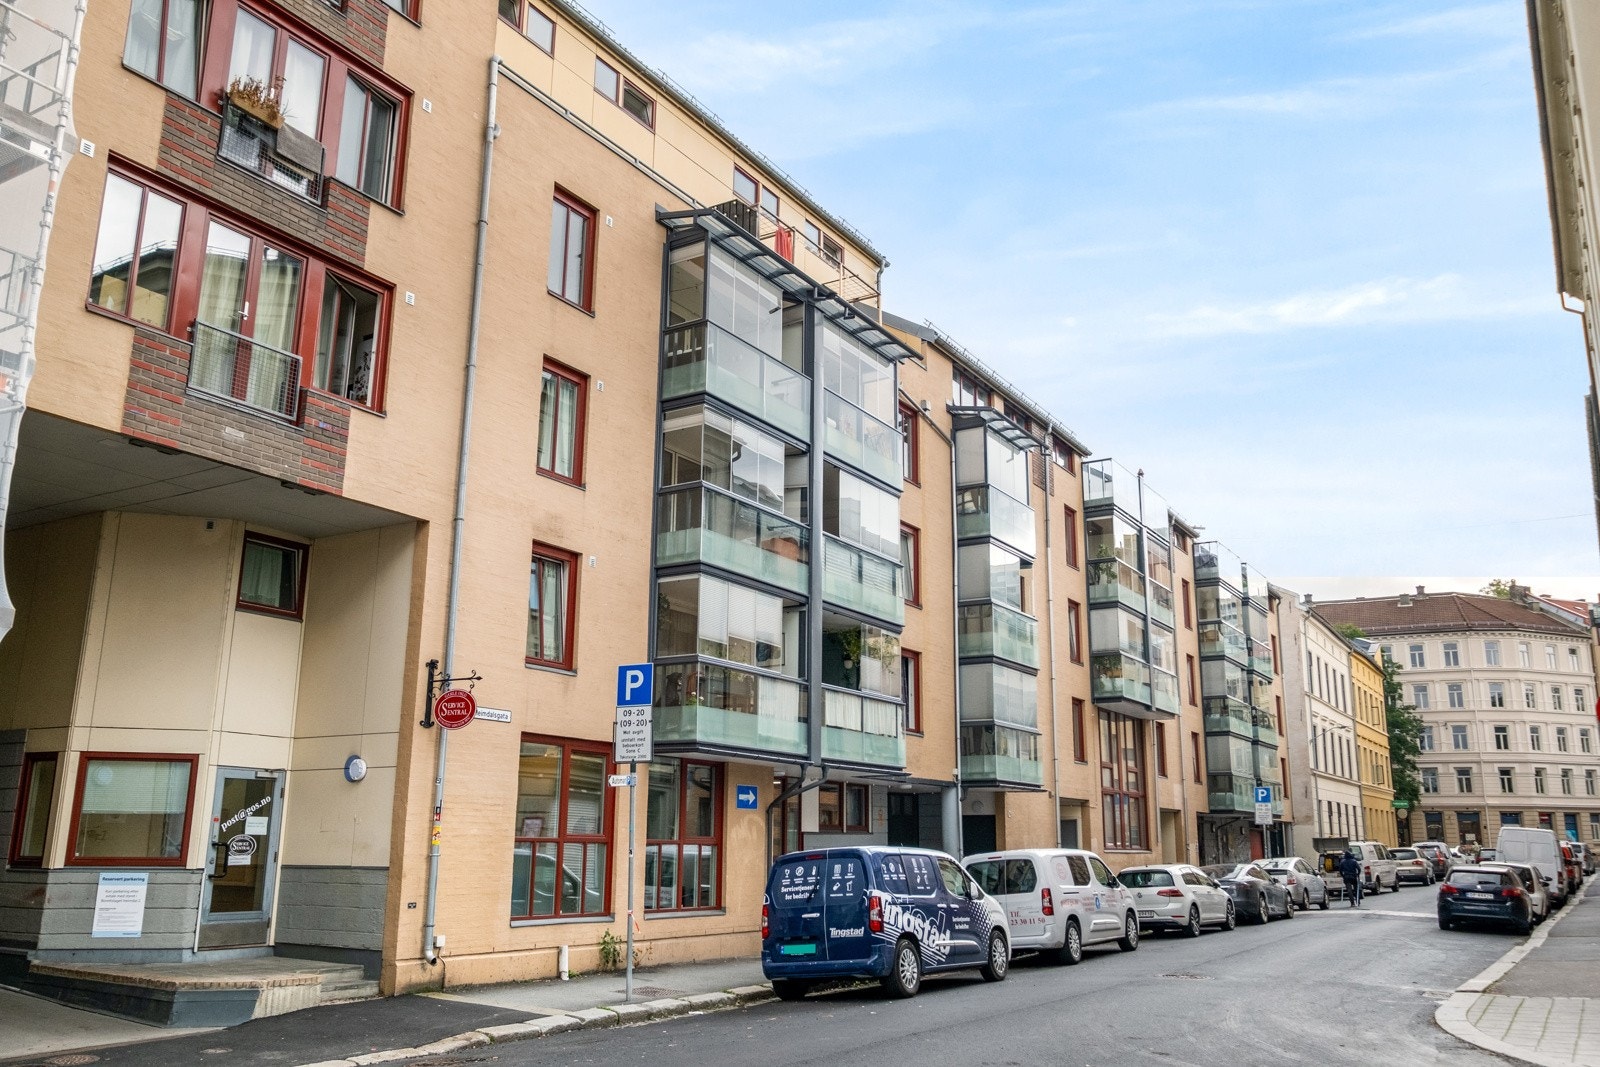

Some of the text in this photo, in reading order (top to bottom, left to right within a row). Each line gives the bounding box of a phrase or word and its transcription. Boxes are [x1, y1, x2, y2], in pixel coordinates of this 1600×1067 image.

[625, 669, 645, 701] P
[441, 701, 466, 712] SERVICE
[1258, 788, 1268, 801] P
[221, 796, 271, 832] post@gos.no
[830, 926, 864, 938] Tingstad
